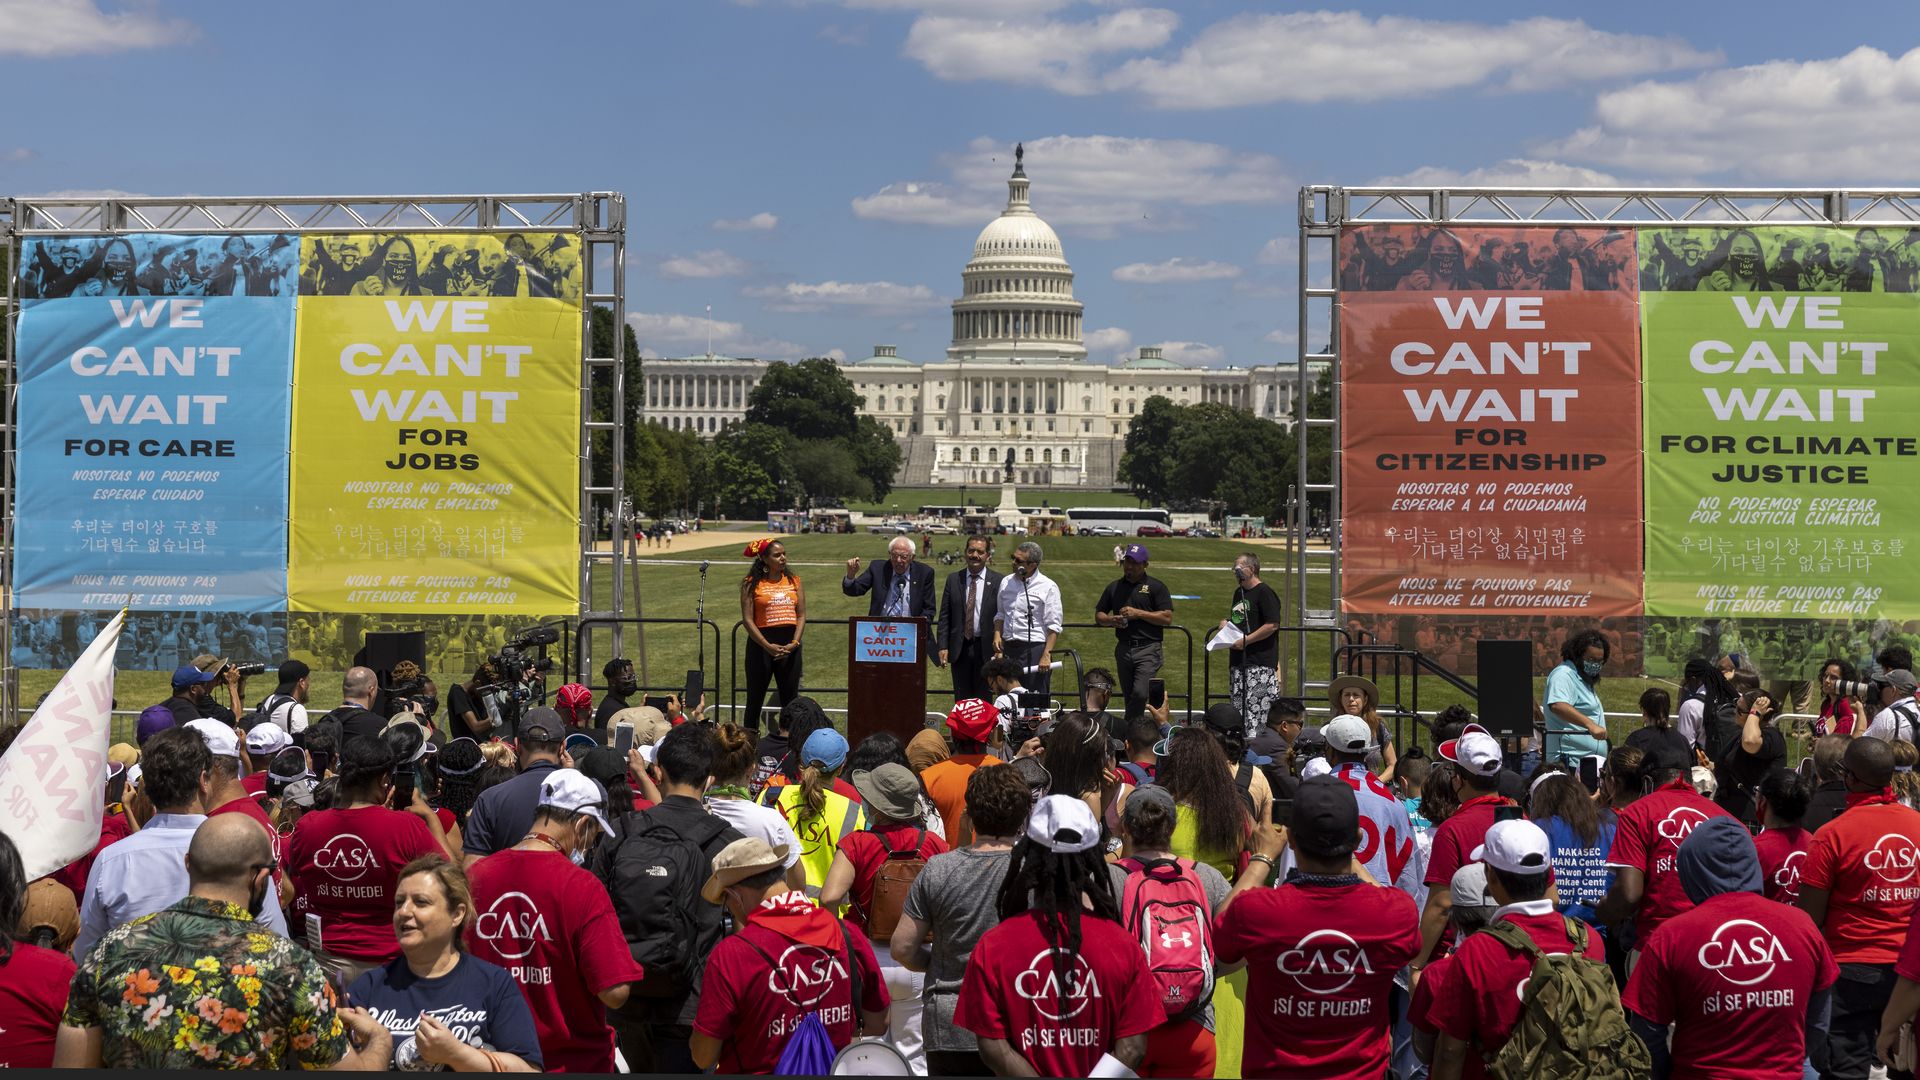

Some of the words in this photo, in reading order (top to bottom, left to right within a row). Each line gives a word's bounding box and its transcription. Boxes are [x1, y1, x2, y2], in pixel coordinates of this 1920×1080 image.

[109, 299, 204, 328] WE
[384, 300, 489, 333] WE
[1433, 297, 1546, 329] WE
[1731, 296, 1844, 329] WE
[70, 346, 241, 376] CAN'T
[339, 343, 532, 377] CAN'T
[1390, 341, 1591, 375] CAN'T
[1689, 340, 1888, 375] CAN'T
[79, 395, 228, 425] WAIT
[351, 389, 518, 423] WAIT
[1402, 389, 1579, 422] WAIT
[1702, 388, 1876, 422] WAIT
[399, 429, 468, 446] FOR
[1455, 429, 1527, 445] FOR
[1660, 435, 1736, 454] FOR
[1745, 436, 1918, 456] CLIMATE
[64, 439, 130, 456] FOR
[138, 439, 236, 457] CARE
[385, 453, 480, 470] JOBS
[1375, 453, 1607, 471] CITIZENSHIP
[72, 470, 132, 482] NOSOTRAS
[137, 470, 154, 482] NO
[161, 470, 220, 483] PODEMOS
[1712, 465, 1869, 484] JUSTICE
[93, 489, 146, 501] ESPERAR
[152, 489, 204, 501] CUIDADO
[343, 481, 413, 494] NOSOTRAS
[419, 482, 440, 495] NO
[448, 482, 513, 495] PODEMOS
[1397, 482, 1469, 495] NOSOTRAS
[1475, 482, 1497, 495] NO
[1504, 482, 1573, 495] PODEMOS
[366, 498, 427, 510] ESPERAR
[435, 498, 499, 511] EMPLEOS
[1391, 499, 1455, 511] ESPERAR
[1461, 499, 1471, 511] A
[1479, 499, 1494, 511] LA
[1503, 495, 1587, 512] CIUDADANÍA
[1698, 497, 1720, 510] NO
[1728, 497, 1802, 511] PODEMOS
[1809, 498, 1877, 512] ESPERAR
[71, 519, 114, 533] 우리는
[122, 519, 165, 534] 더이상
[1689, 511, 1721, 523] POR
[1729, 511, 1796, 525] JUSTICIA
[331, 524, 383, 543] 우리는
[393, 525, 445, 544] 더이상
[454, 526, 527, 544] 일자리를
[1384, 527, 1438, 544] 우리는
[1450, 526, 1503, 544] 더이상
[1514, 527, 1586, 544] 시민권을
[81, 538, 139, 553] 기다릴수
[147, 538, 207, 553] 없습니다
[358, 542, 427, 560] 기다릴수
[437, 541, 508, 560] 없습니다
[1412, 543, 1484, 561] 기다릴수
[1495, 543, 1568, 561] 없습니다
[1677, 536, 1734, 554] 우리는
[1746, 537, 1801, 555] 더이상
[1813, 537, 1904, 557] 기후보호를
[1711, 554, 1787, 573] 기다릴수
[1799, 555, 1873, 574] 없습니다
[72, 574, 104, 586] NOUS
[109, 574, 125, 586] NE
[132, 575, 187, 587] POUVONS
[193, 576, 217, 587] PAS
[344, 575, 381, 587] NOUS
[388, 575, 408, 587] NE
[415, 576, 478, 588] POUVONS
[484, 576, 511, 589] PAS
[1398, 578, 1437, 590] NOUS
[1444, 578, 1463, 590] NE
[1472, 578, 1536, 591] POUVONS
[1544, 579, 1572, 591] PAS
[82, 594, 145, 605] ATTENDRE
[150, 594, 170, 606] LES
[178, 595, 215, 606] SOINS
[346, 590, 419, 603] ATTENDRE
[425, 591, 450, 604] LES
[456, 591, 517, 604] EMPLOIS
[1389, 594, 1462, 606] ATTENDRE
[1470, 594, 1486, 606] LA
[1494, 590, 1591, 607] CITOYENNETÉ
[1696, 585, 1738, 599] NOUS
[1749, 585, 1769, 599] NE
[1776, 586, 1845, 600] POUVONS
[1855, 587, 1882, 600] PAS
[1704, 600, 1783, 613] ATTENDRE
[1792, 600, 1809, 613] LE
[1819, 601, 1875, 614] CLIMAT
[873, 625, 897, 634] WE
[863, 636, 907, 646] CAN'T
[867, 648, 905, 657] WAIT
[791, 820, 836, 848] ASA
[313, 848, 381, 868] CASA
[1558, 847, 1601, 856] NAKASEC
[1551, 858, 1577, 866] HANA
[1553, 867, 1582, 876] inKwon
[331, 886, 344, 897] SE
[346, 885, 383, 898] PUEDE!
[1557, 887, 1575, 896] oori
[1880, 888, 1892, 901] SE
[1894, 887, 1920, 900] PUED
[476, 911, 553, 942] CASA
[1698, 934, 1792, 971] CASA
[1276, 948, 1375, 976] CASA
[511, 966, 552, 985] PUEDE!
[768, 955, 848, 996] CASA
[1014, 968, 1101, 1000] CASA
[1297, 1001, 1315, 1018] SE
[1320, 998, 1371, 1018] PUEDE!
[1725, 994, 1742, 1012] SE
[1746, 988, 1794, 1010] PUEDE!
[820, 1004, 851, 1026] EDE!
[1041, 1028, 1056, 1047] SE
